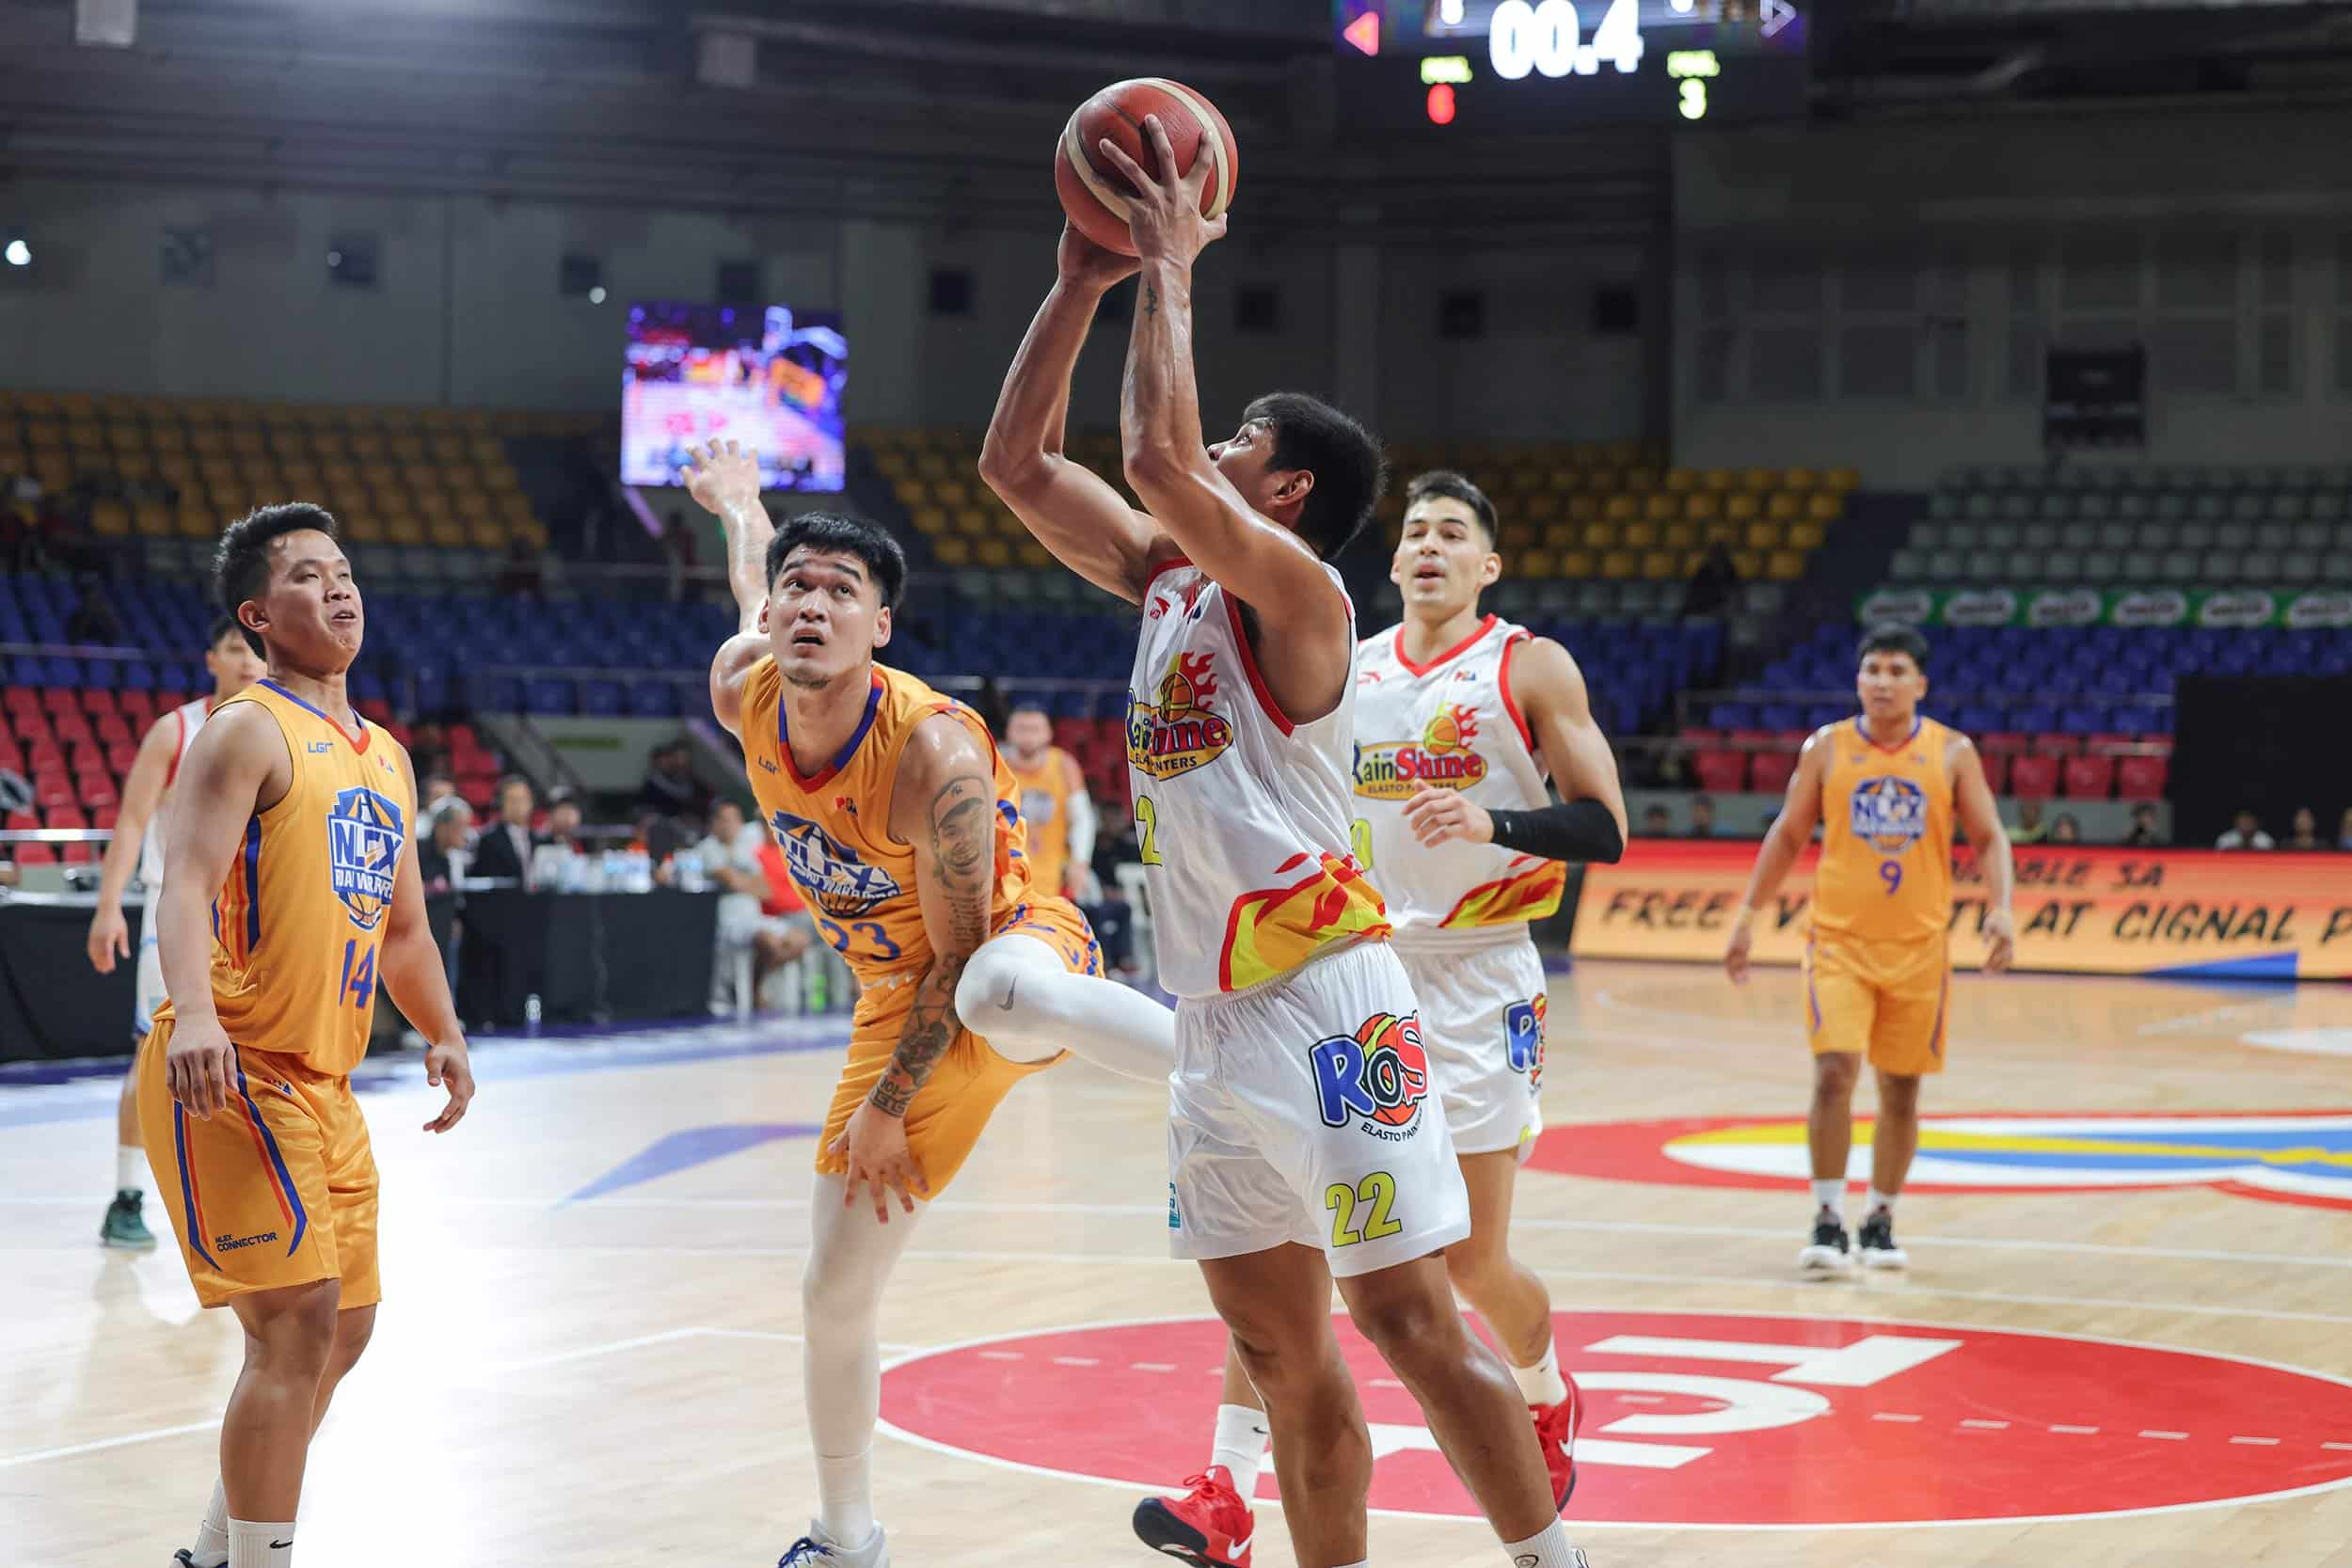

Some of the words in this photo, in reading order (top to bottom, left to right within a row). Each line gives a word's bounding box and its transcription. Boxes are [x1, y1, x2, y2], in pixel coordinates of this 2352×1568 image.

[1489, 0, 1644, 79] 00.4
[1678, 77, 1707, 119] 3
[1395, 748, 1483, 782] Shine
[1880, 860, 1902, 896] 9
[1602, 888, 1737, 930] FREE
[2025, 899, 2094, 935] AT
[2113, 903, 2296, 945] CIGNAL
[340, 939, 375, 1009] 14
[1360, 1121, 1402, 1142] ELASTO
[1325, 1172, 1403, 1248] 22
[216, 1231, 278, 1253] CONNECTOR
